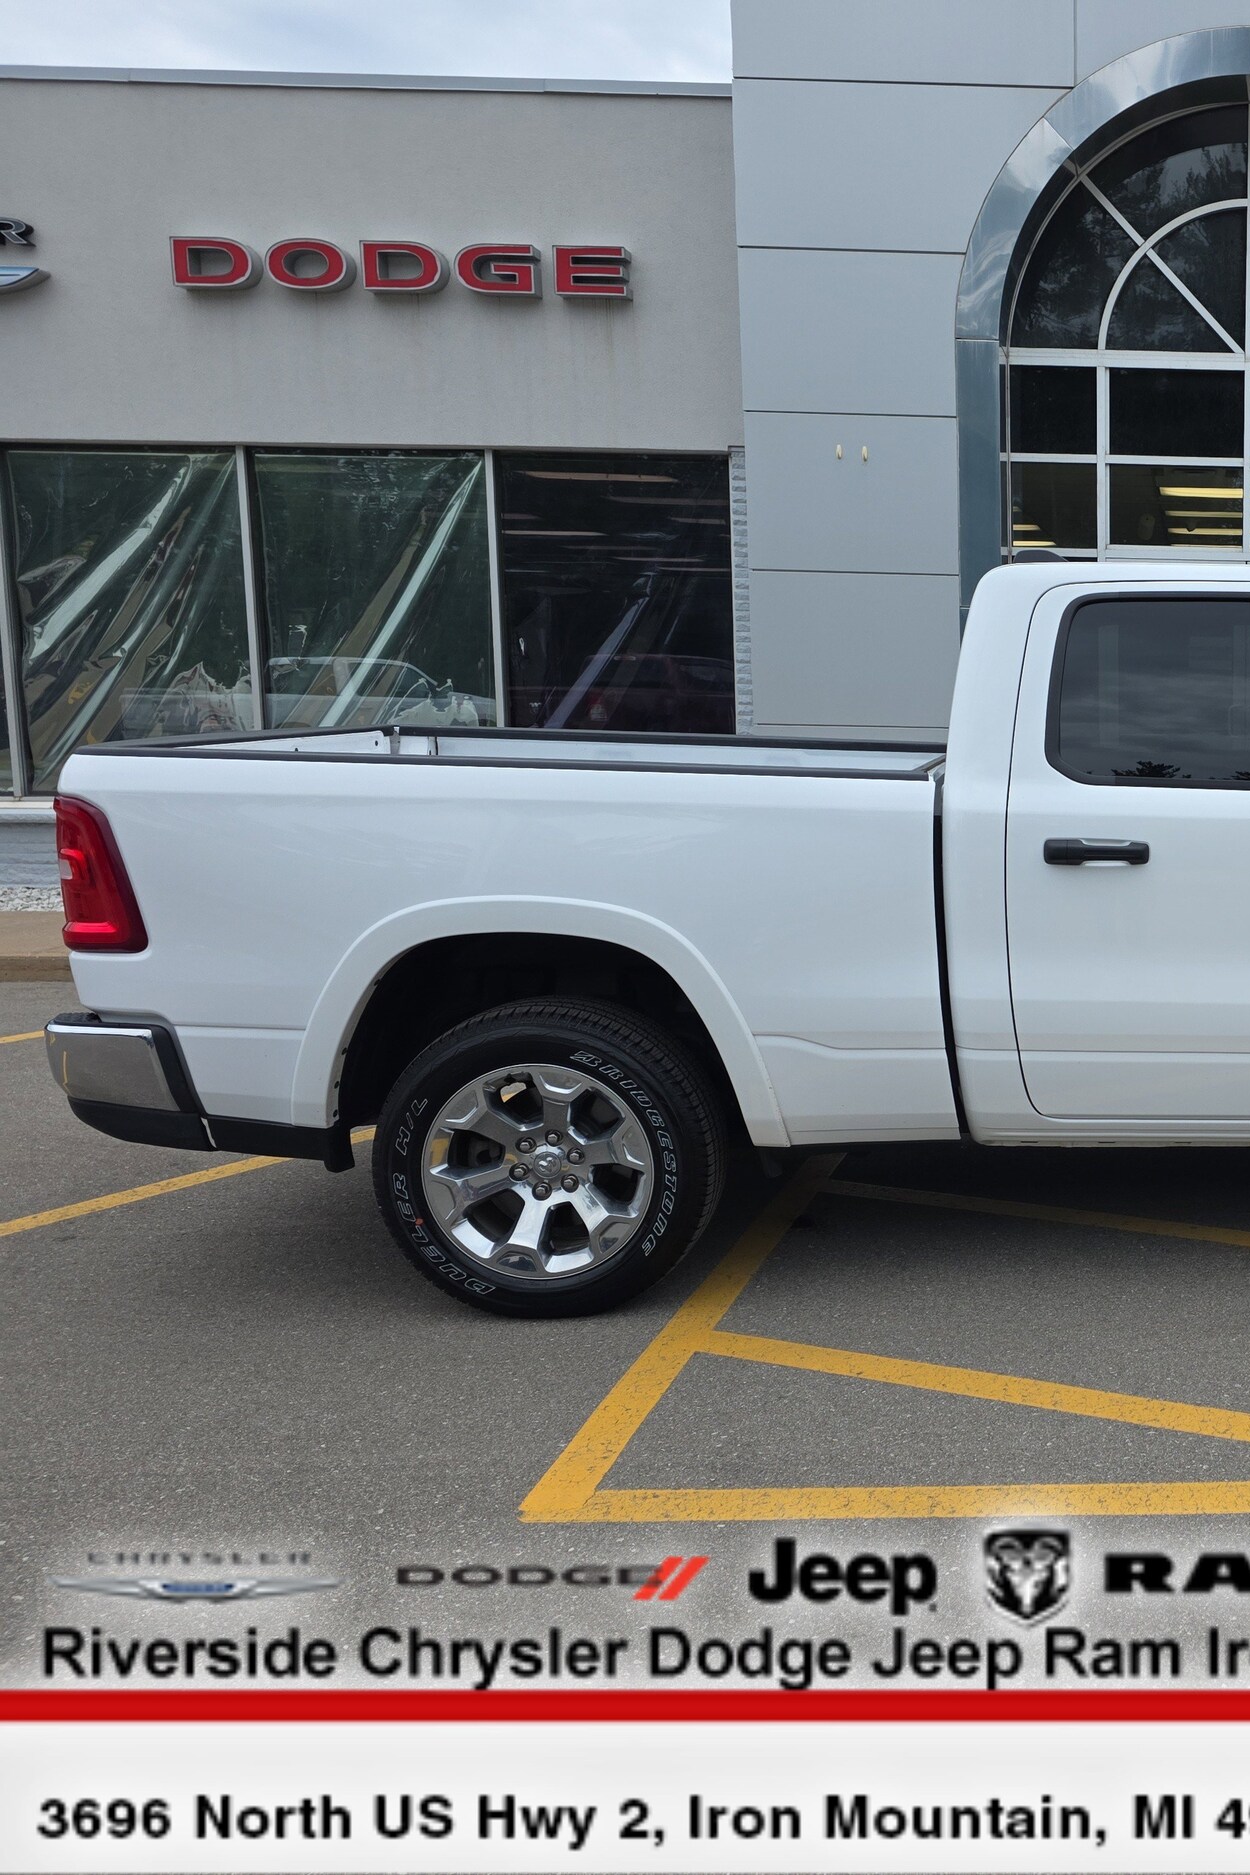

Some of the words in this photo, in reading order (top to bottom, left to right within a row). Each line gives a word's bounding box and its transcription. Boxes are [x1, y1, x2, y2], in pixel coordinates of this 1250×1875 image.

[168, 236, 633, 300] DODGE
[395, 1098, 428, 1156] H/L
[570, 1050, 678, 1257] BRIDGESTONE
[393, 1172, 496, 1295] DUELER
